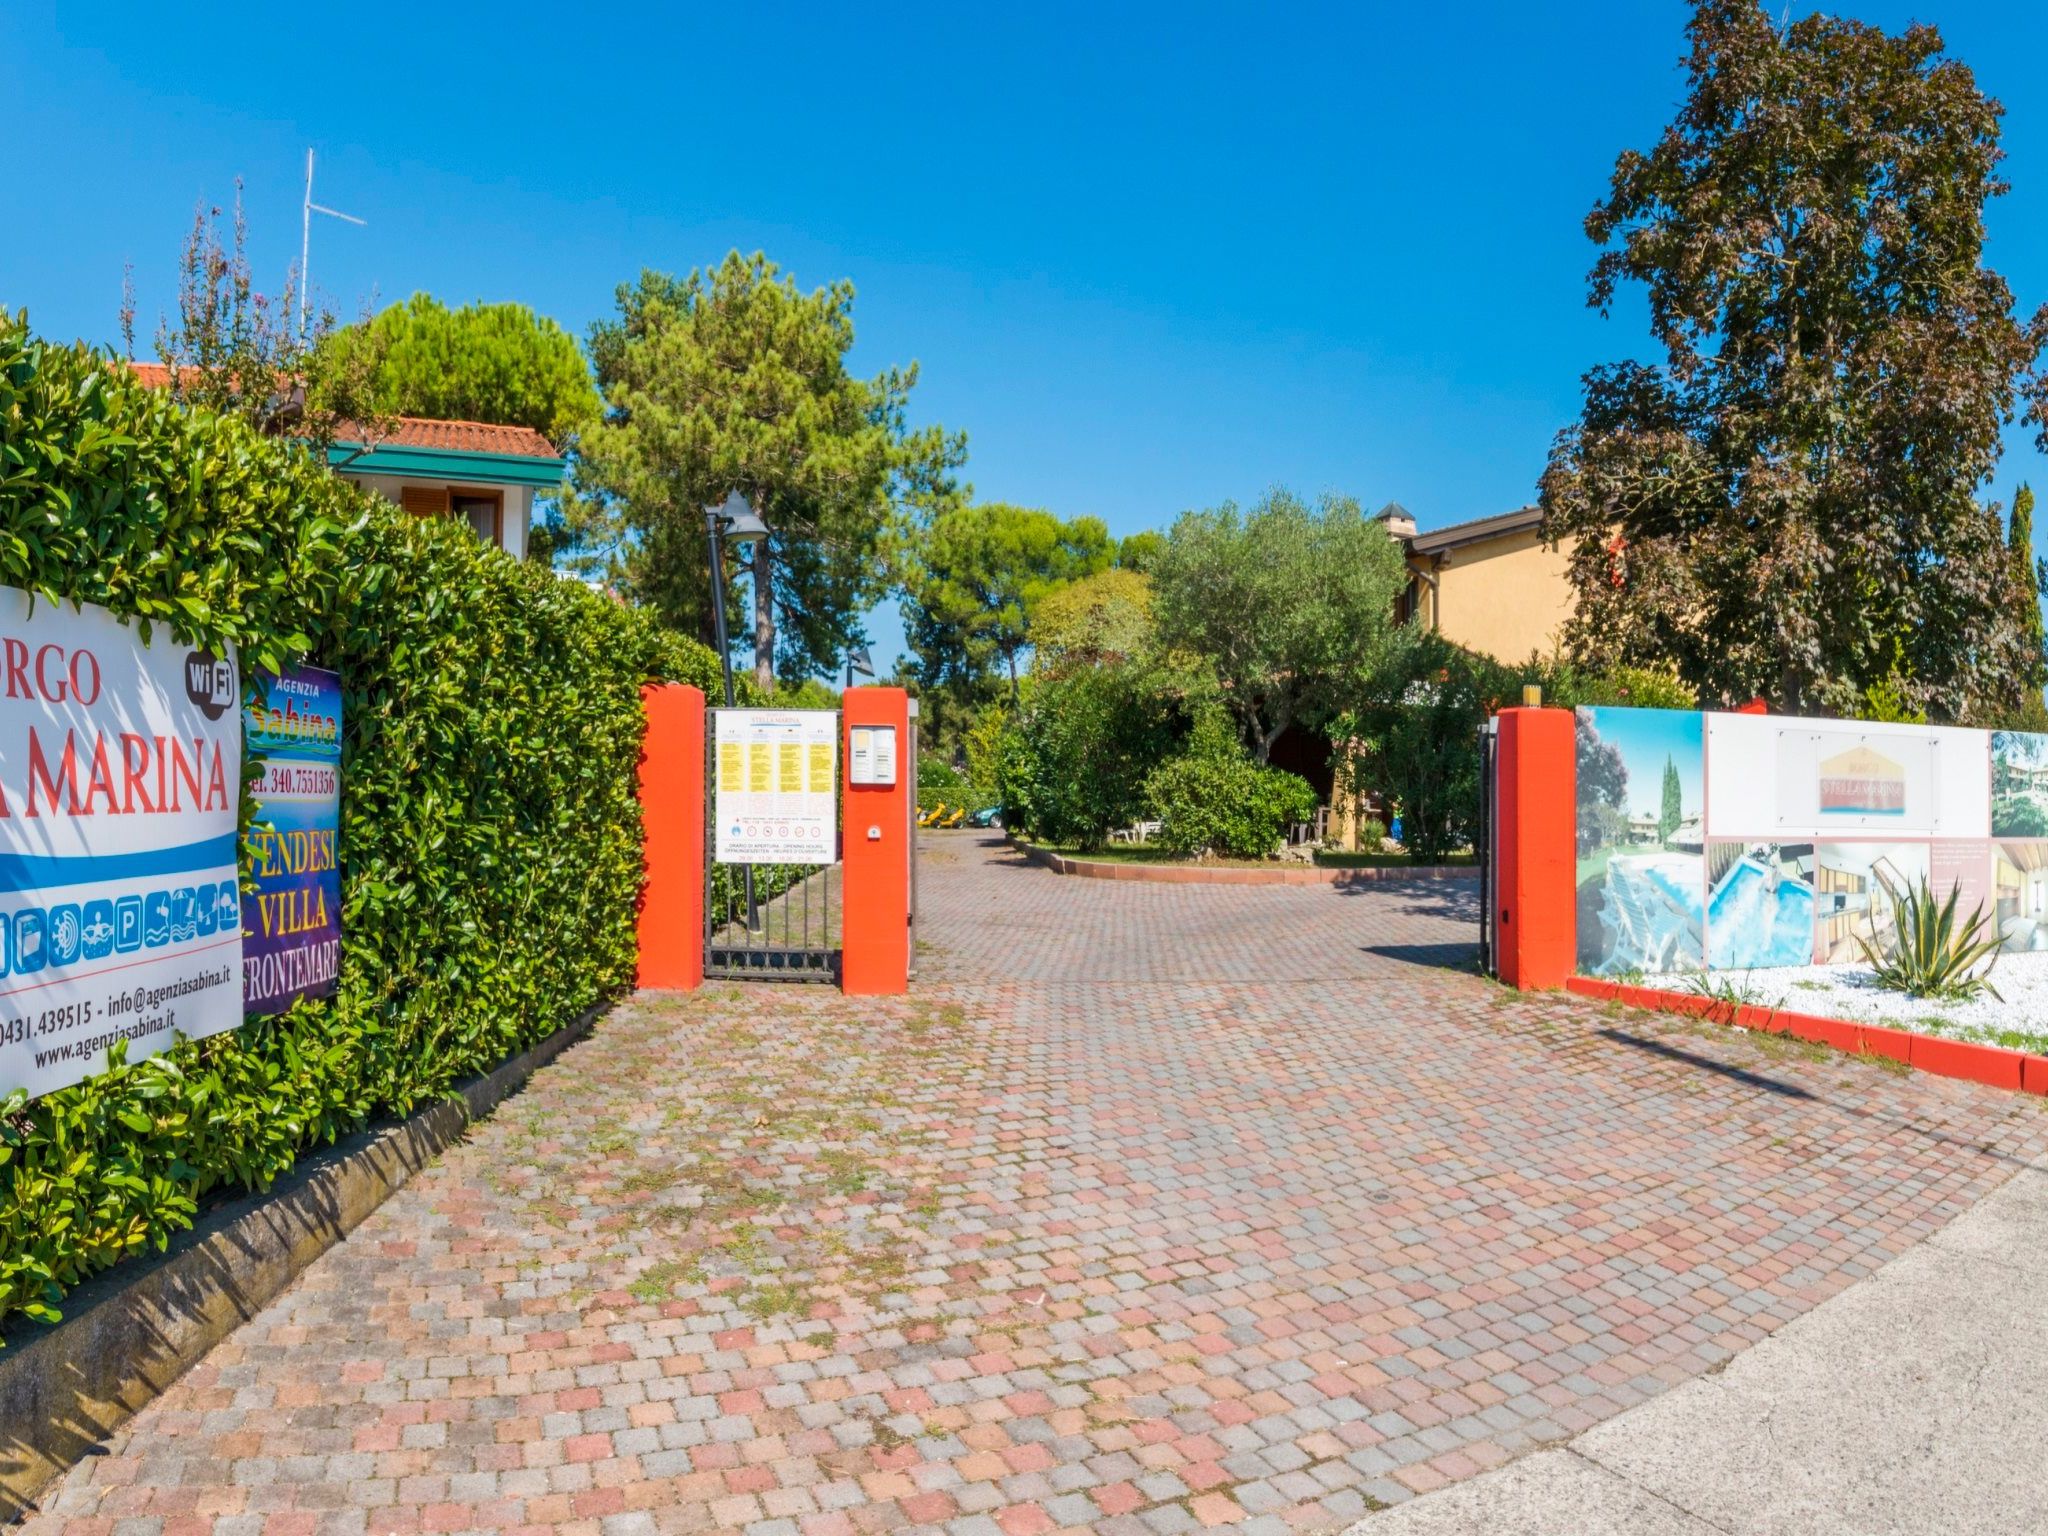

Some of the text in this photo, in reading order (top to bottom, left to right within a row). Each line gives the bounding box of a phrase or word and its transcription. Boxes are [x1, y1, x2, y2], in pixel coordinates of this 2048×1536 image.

[0, 637, 101, 706] RGO
[275, 677, 320, 698] AGENZIA
[249, 696, 337, 745] Sabina
[25, 725, 229, 818] MARINA
[271, 767, 335, 794] 340.7551356
[241, 830, 336, 877] VENDESI
[258, 886, 328, 938] VILLA
[107, 965, 231, 1017] info@agenziasabina.it
[35, 1009, 175, 1069] www.agenziasabina.it
